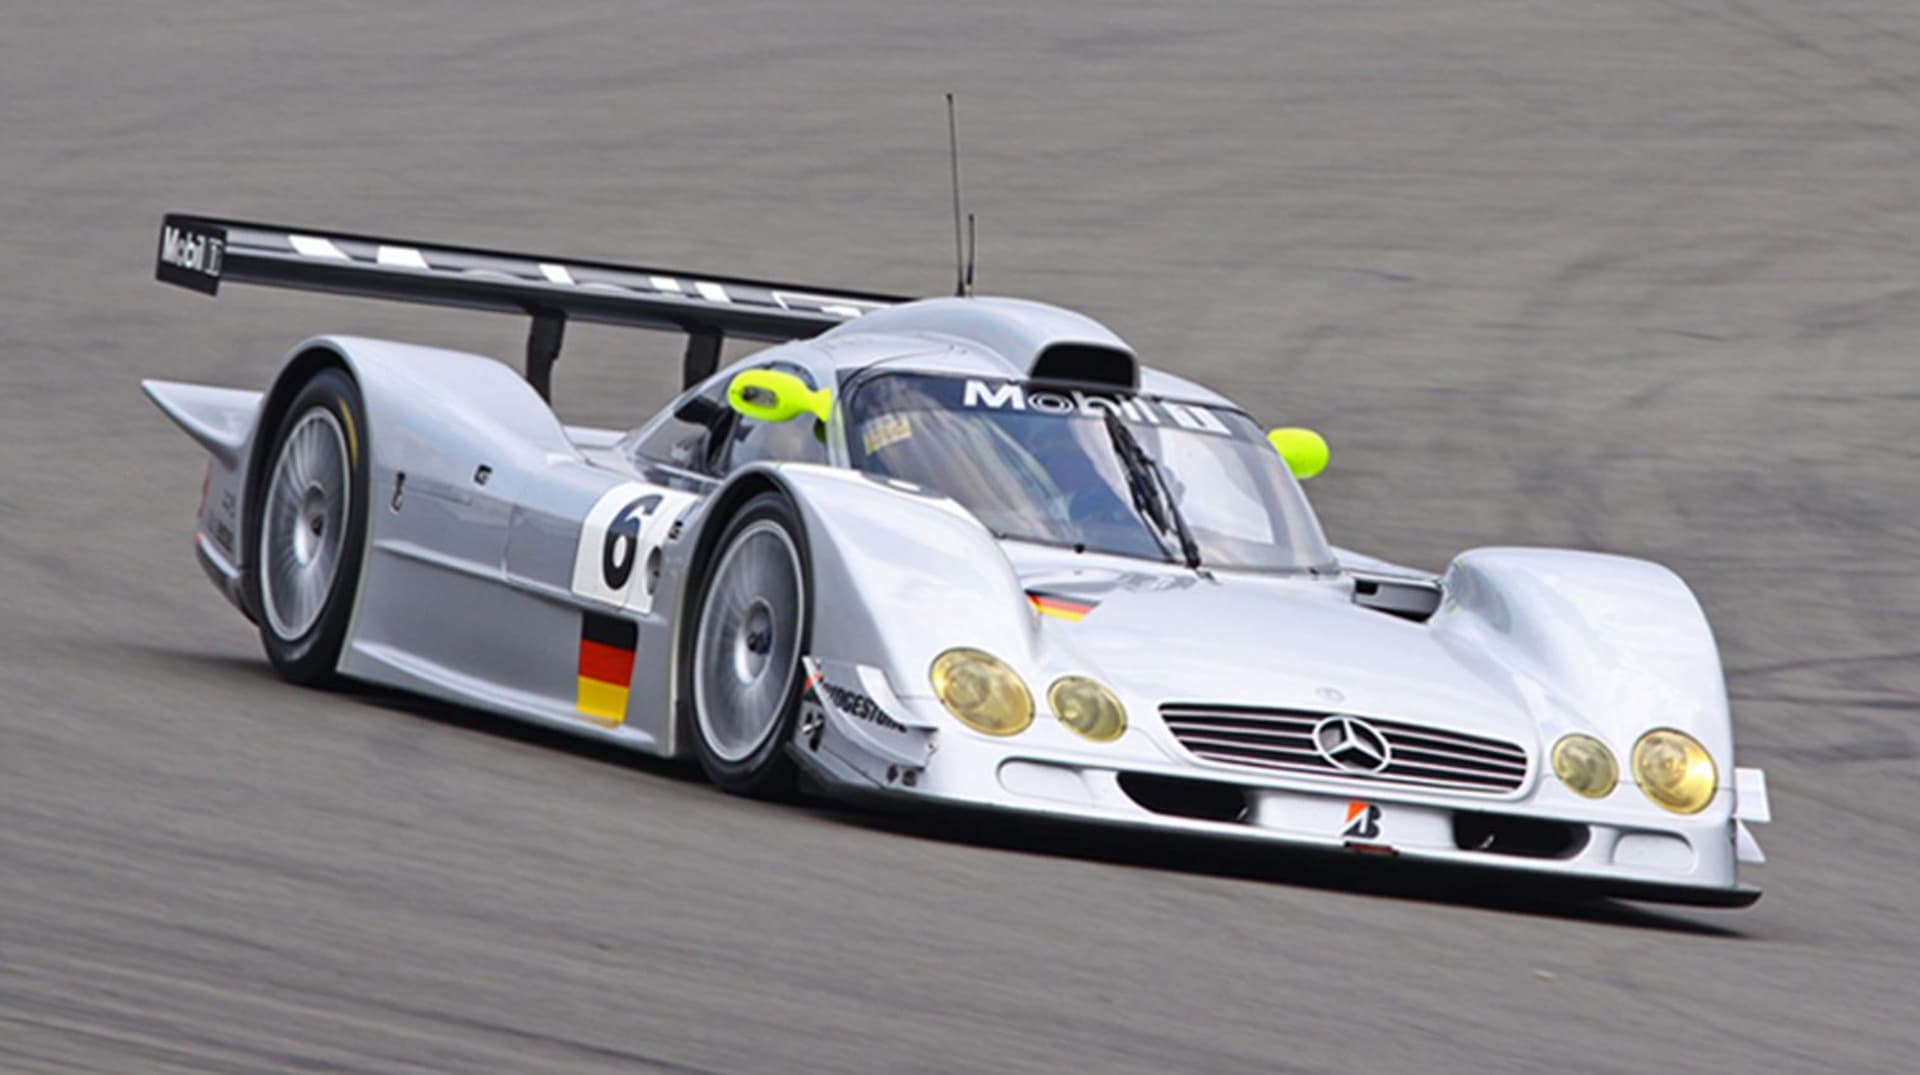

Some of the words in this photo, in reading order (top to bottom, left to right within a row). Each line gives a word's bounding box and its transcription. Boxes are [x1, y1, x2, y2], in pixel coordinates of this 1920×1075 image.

[162, 226, 205, 271] Mobil
[963, 380, 1159, 424] Mobil
[602, 494, 664, 591] 6
